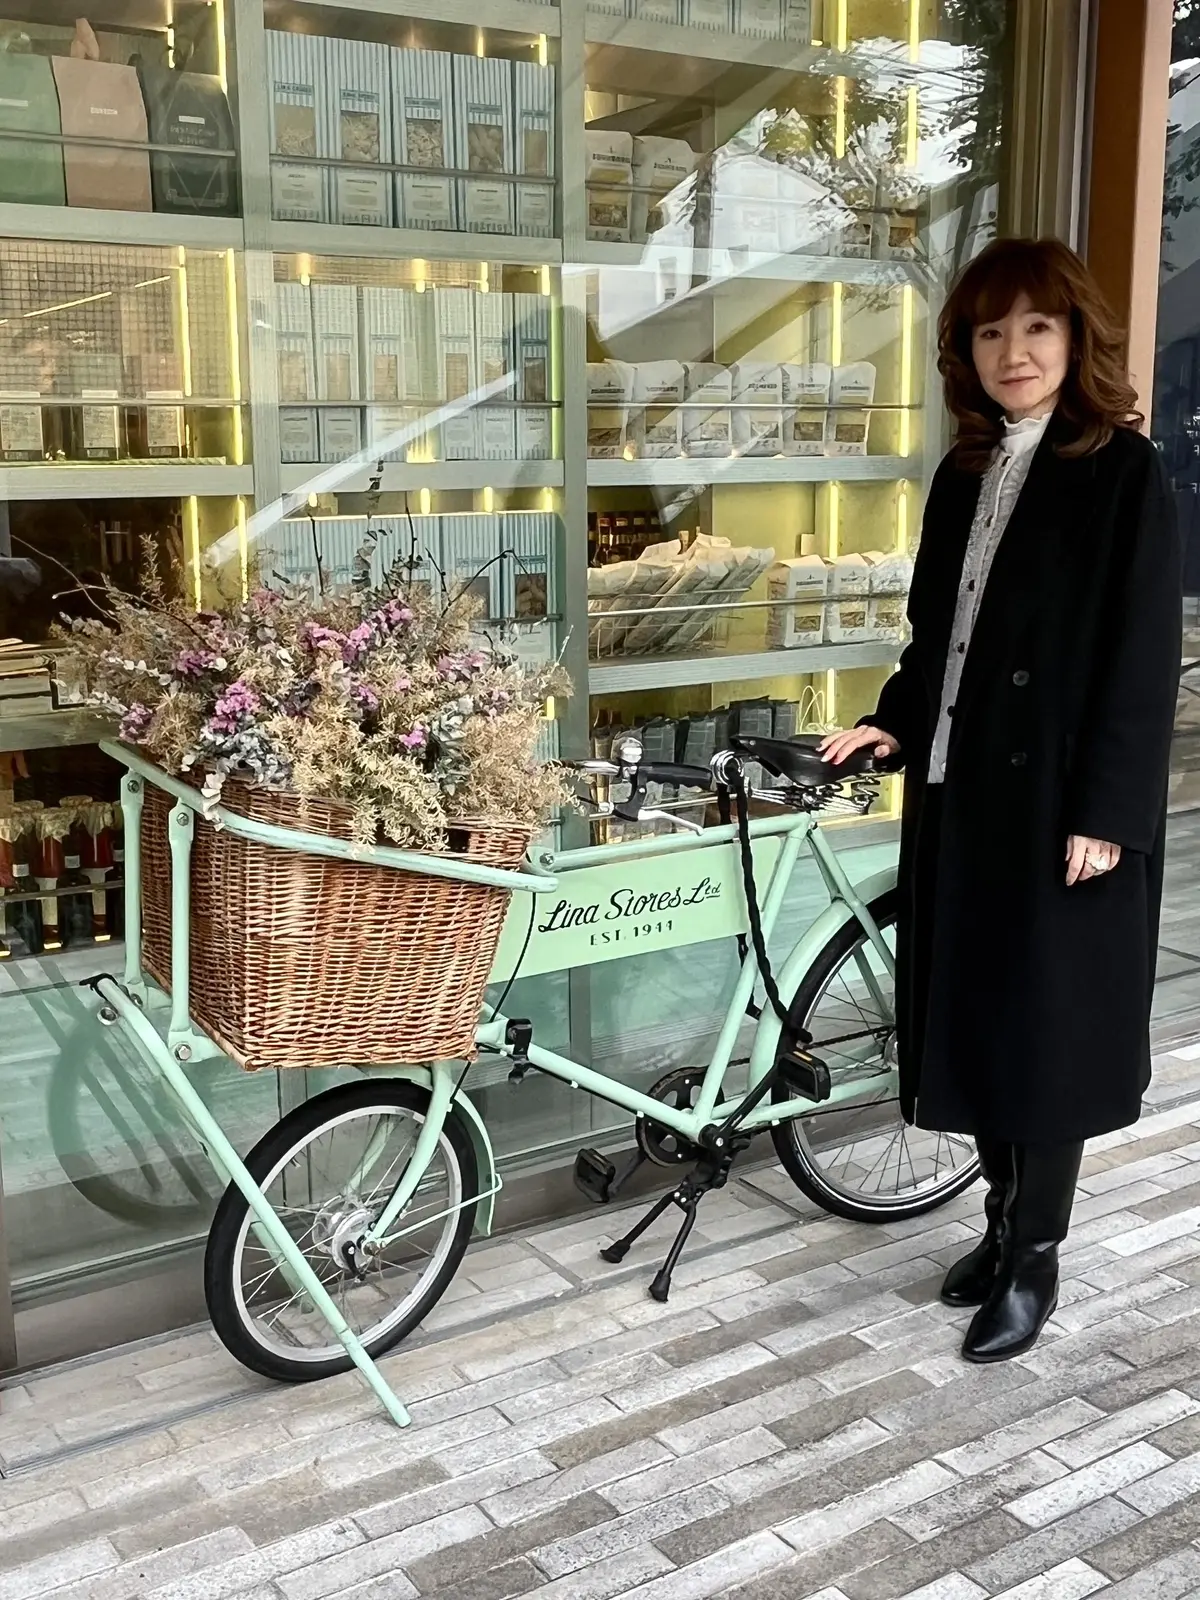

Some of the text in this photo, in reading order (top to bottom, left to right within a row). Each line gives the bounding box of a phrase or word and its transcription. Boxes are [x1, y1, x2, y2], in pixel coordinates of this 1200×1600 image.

[538, 877, 721, 933] Lina Stores Ltd
